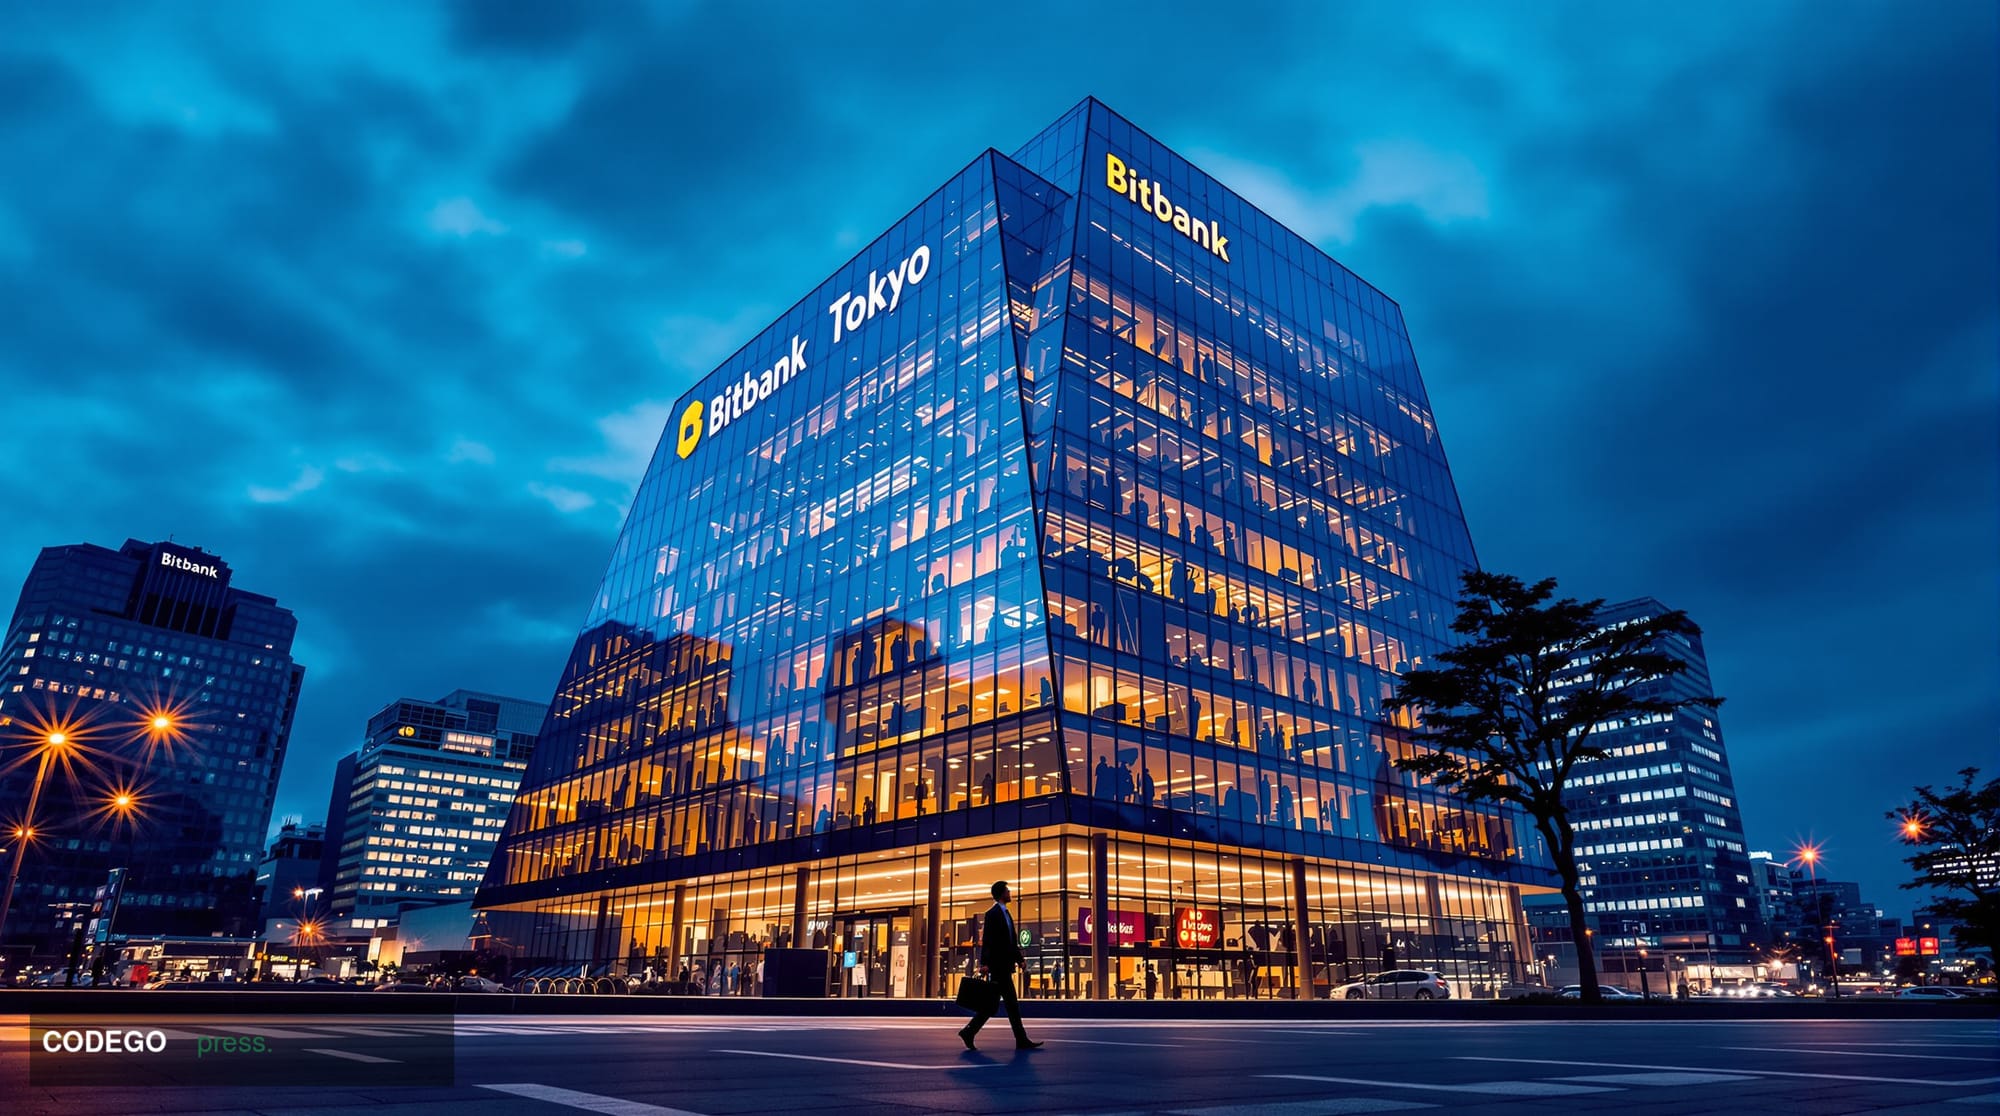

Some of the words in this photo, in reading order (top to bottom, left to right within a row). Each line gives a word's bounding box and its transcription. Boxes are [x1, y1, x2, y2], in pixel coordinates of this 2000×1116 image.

[1106, 153, 1230, 264] Bitbank
[708, 335, 809, 437] Bitbank
[829, 245, 931, 344] Tokyo
[161, 552, 219, 579] Bitbank
